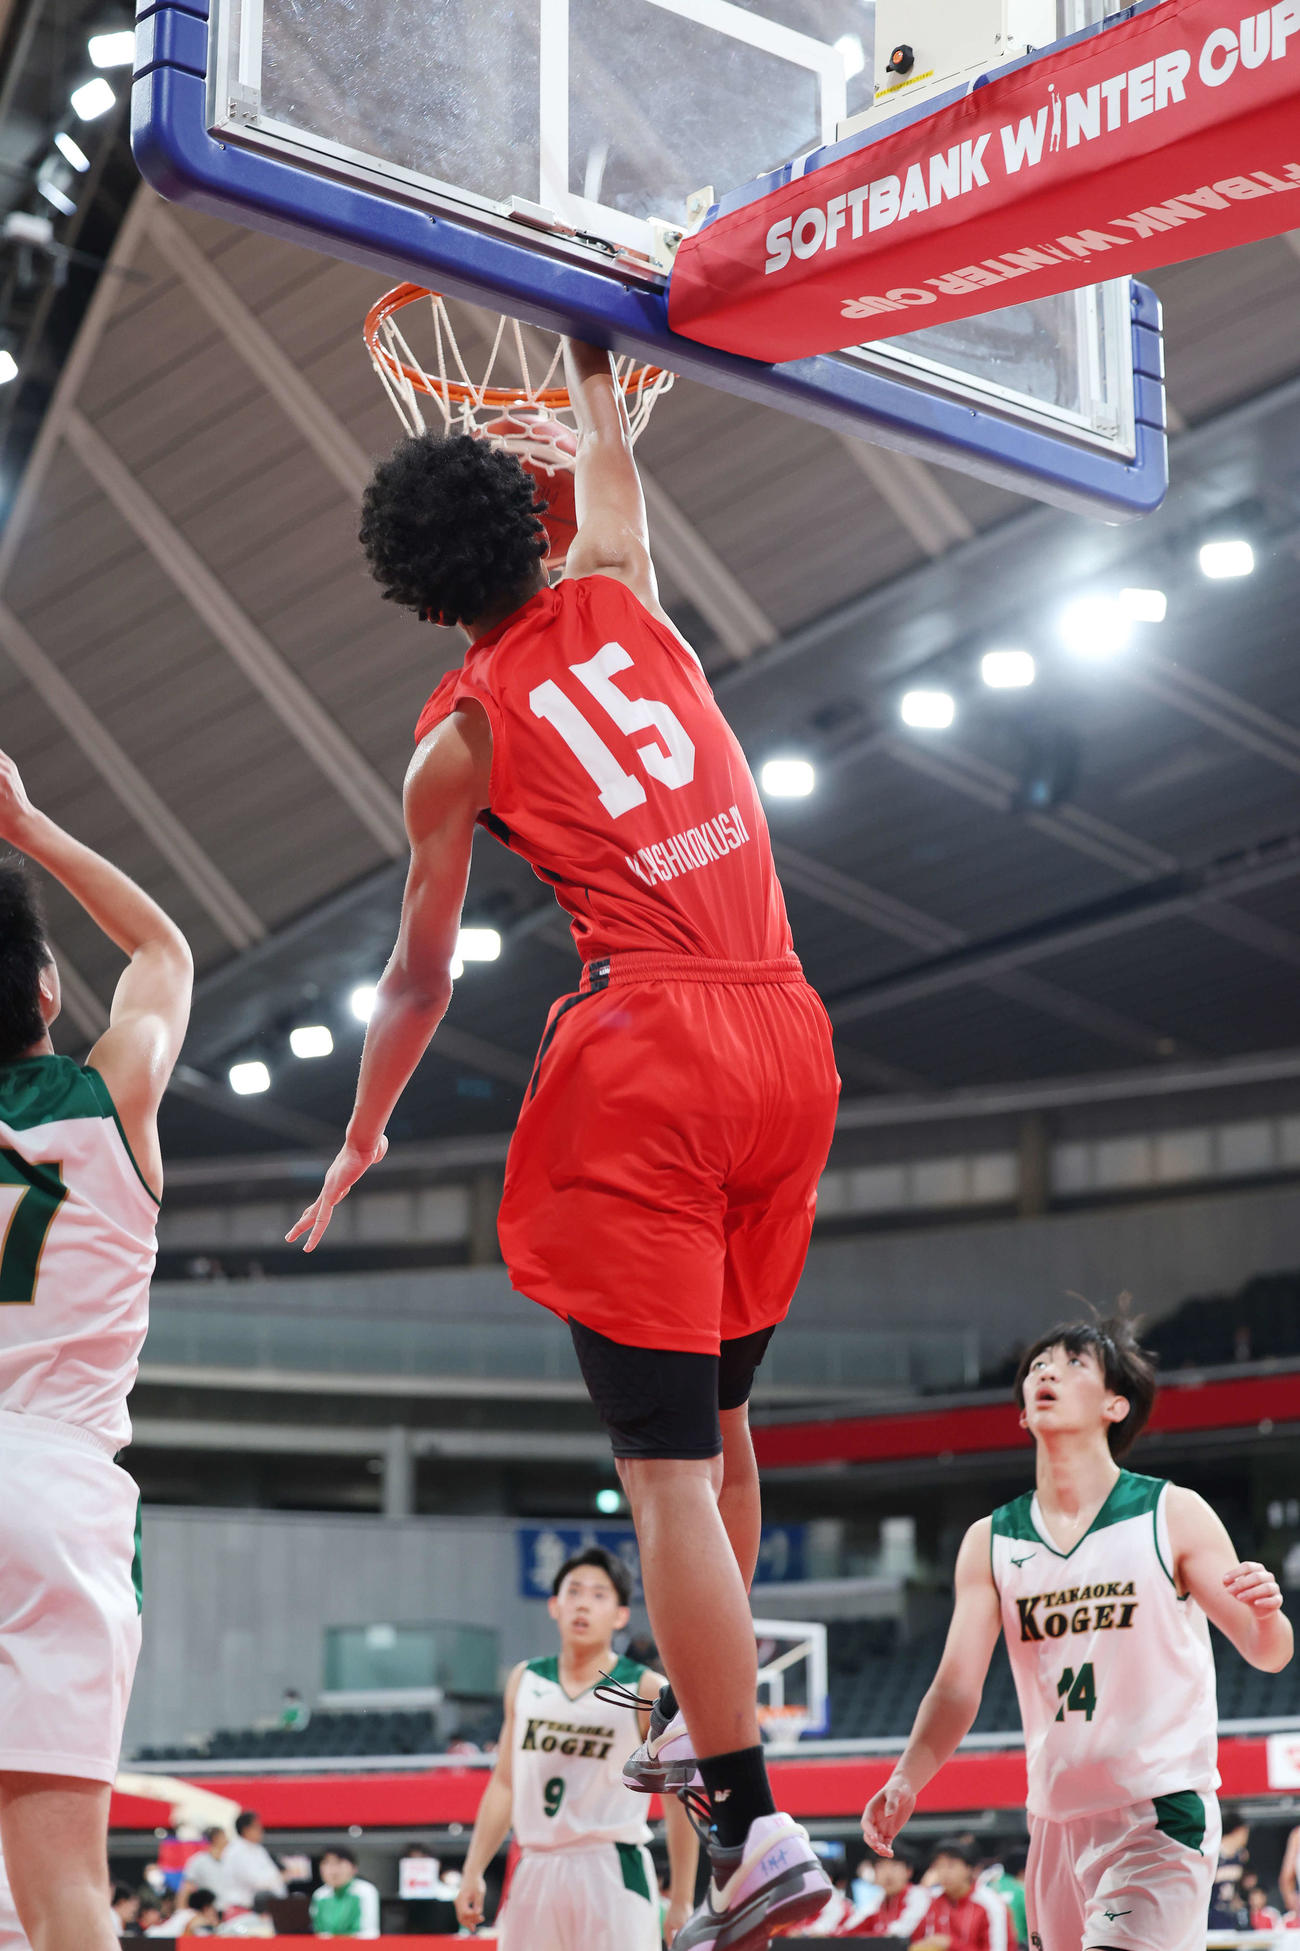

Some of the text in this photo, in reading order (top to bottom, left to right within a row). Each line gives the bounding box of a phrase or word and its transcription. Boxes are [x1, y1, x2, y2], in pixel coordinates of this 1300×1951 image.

[765, 0, 1300, 275] SOFTBANK WINTER CUP
[840, 288, 937, 319] CUP
[529, 641, 695, 819] 15
[1044, 1581, 1136, 1608] TAKAOKA
[1016, 1597, 1138, 1642] KOGEI
[1055, 1662, 1097, 1722] 14
[521, 1717, 613, 1761] KOGEI
[543, 1776, 566, 1818] 9
